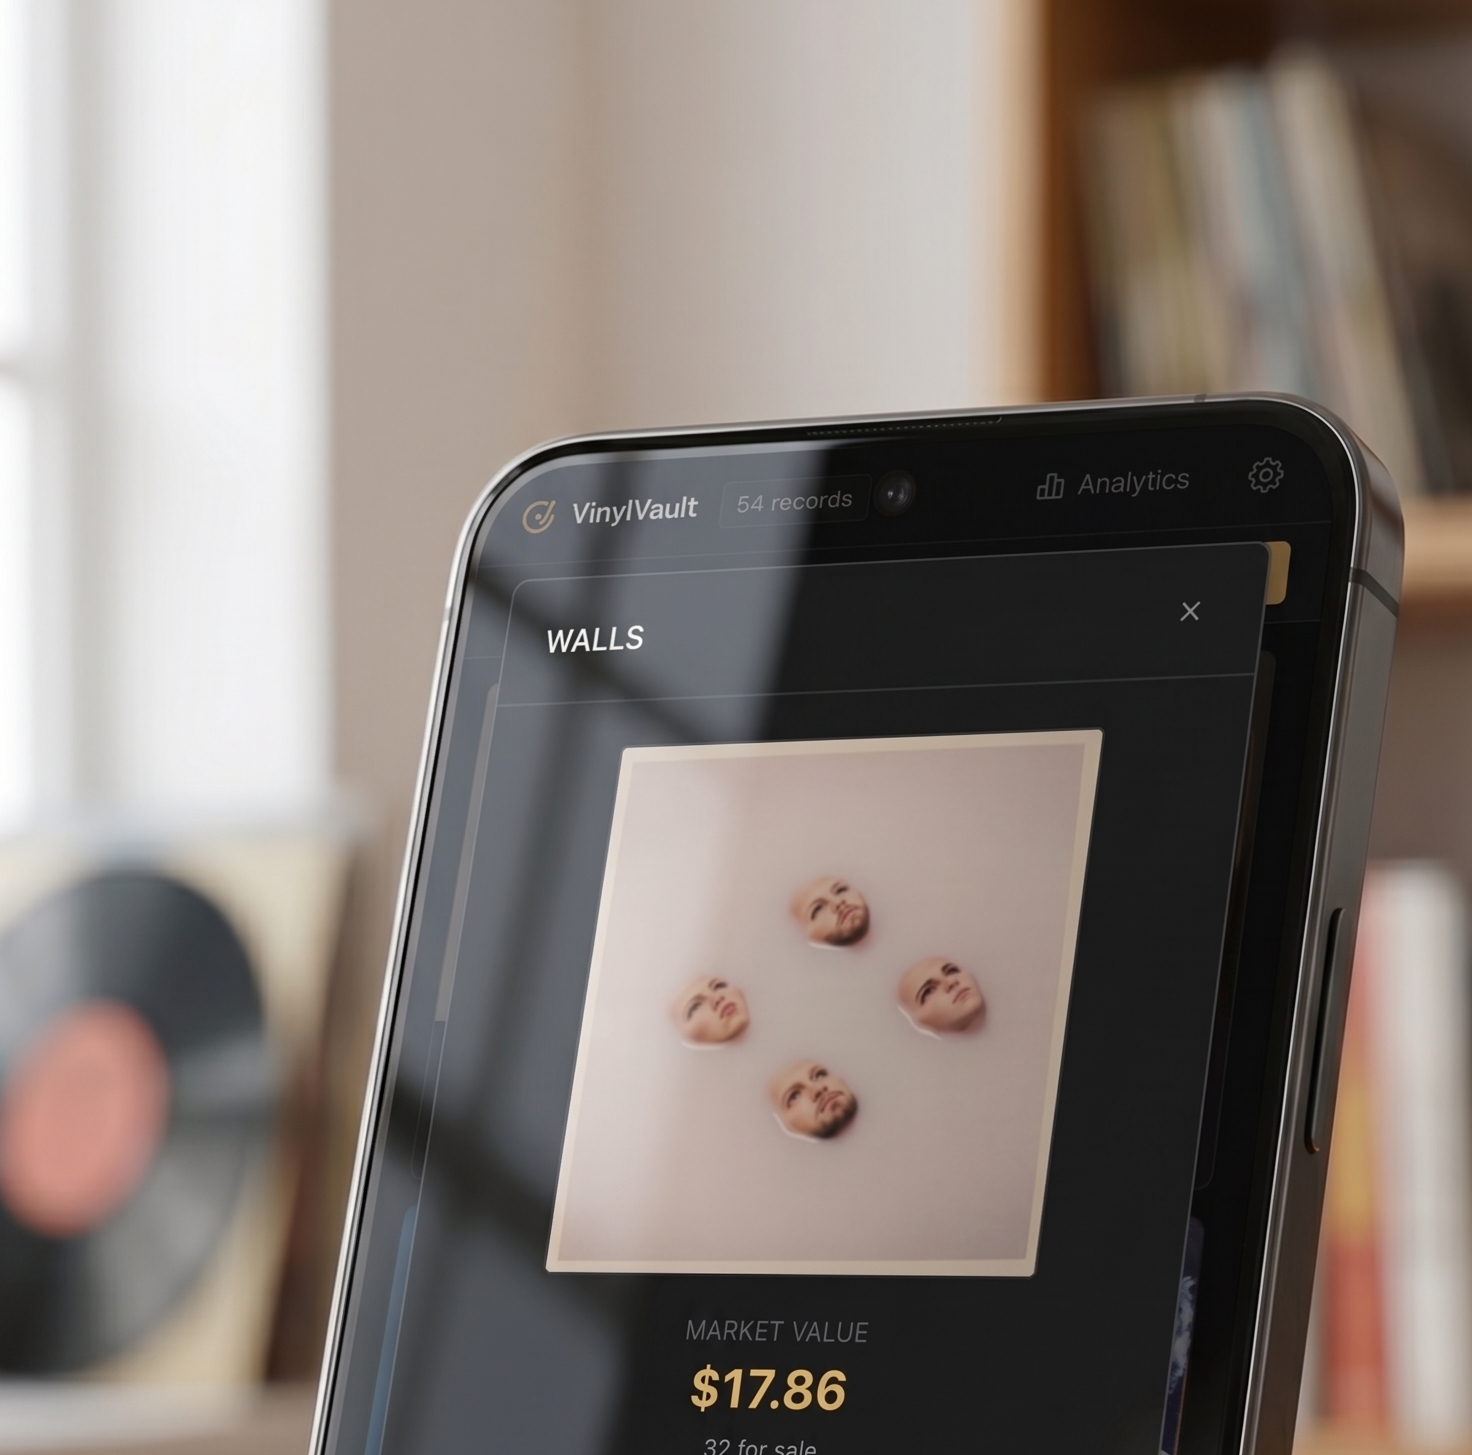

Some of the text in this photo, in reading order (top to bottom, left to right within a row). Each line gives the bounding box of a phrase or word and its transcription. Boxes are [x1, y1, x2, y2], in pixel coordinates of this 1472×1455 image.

[1077, 470, 1190, 497] Analytics
[573, 497, 698, 527] VinylVault
[737, 490, 853, 514] 54 records
[547, 625, 645, 654] WALLS
[686, 1319, 869, 1343] MARKET VALUE
[690, 1363, 847, 1413] $17.86
